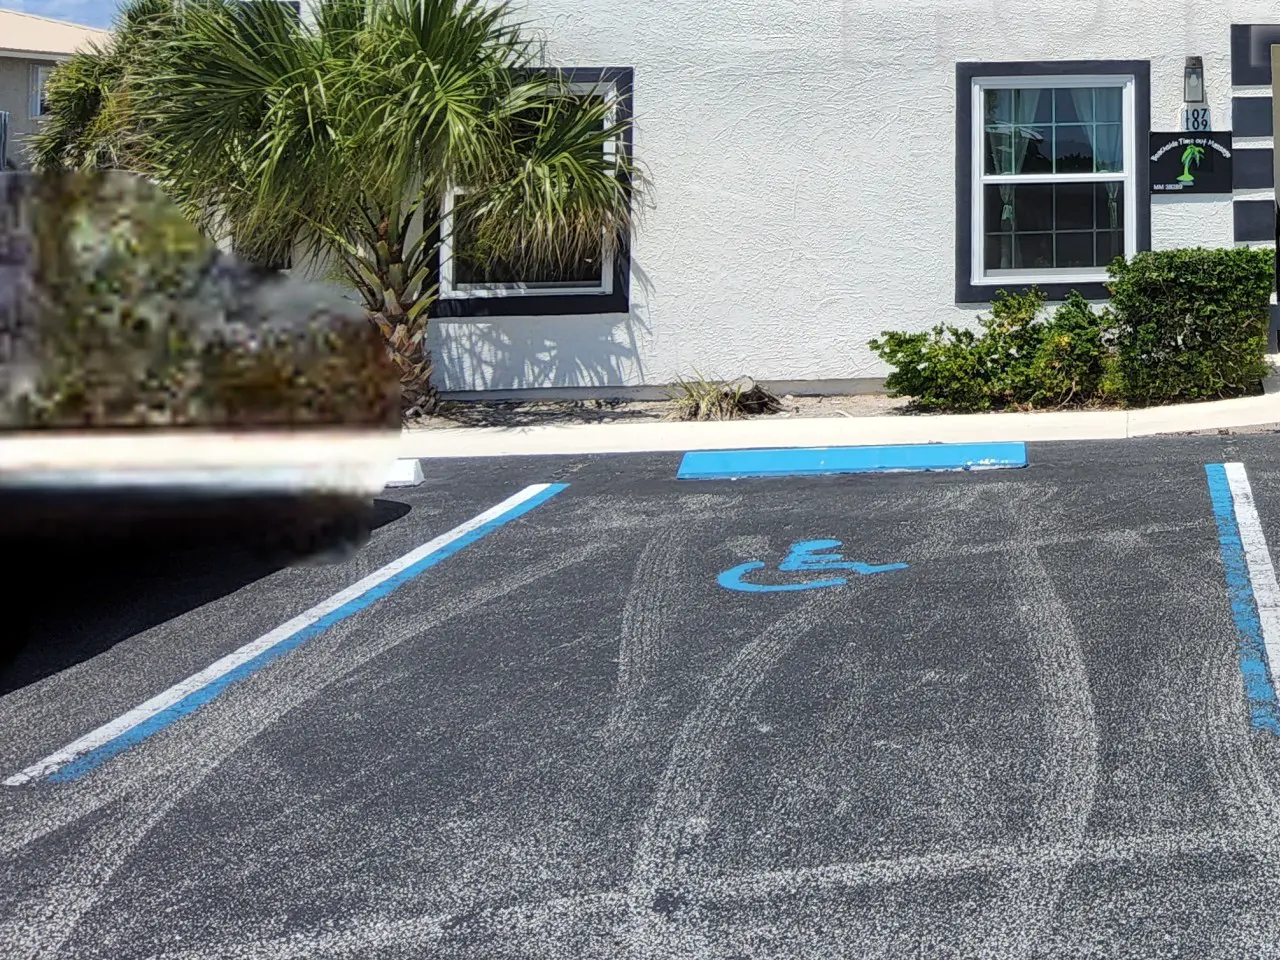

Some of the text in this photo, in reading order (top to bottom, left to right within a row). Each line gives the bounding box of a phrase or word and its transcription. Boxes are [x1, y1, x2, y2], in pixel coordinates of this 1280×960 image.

[1186, 108, 1207, 120] 107
[1186, 118, 1208, 130] 109
[1178, 137, 1194, 145] Time
[1207, 139, 1231, 158] Massage
